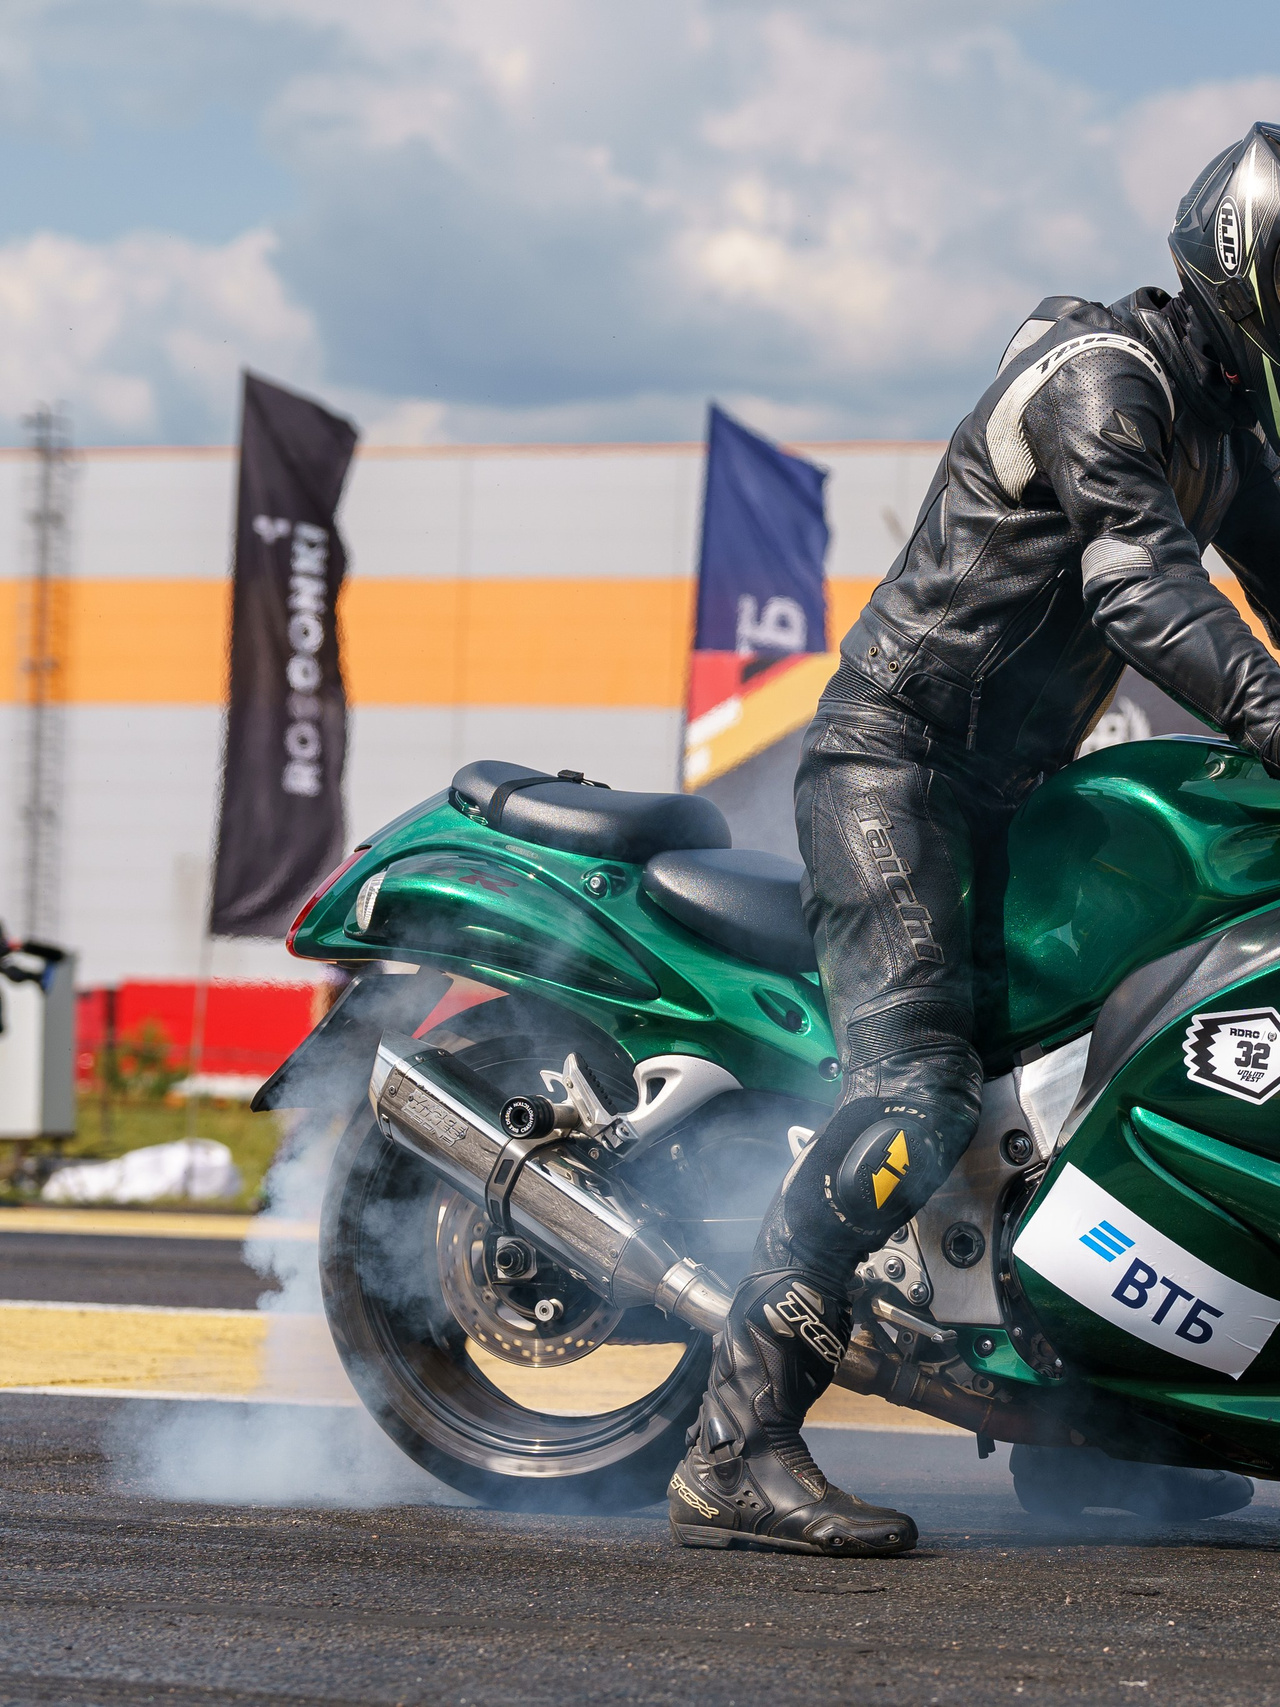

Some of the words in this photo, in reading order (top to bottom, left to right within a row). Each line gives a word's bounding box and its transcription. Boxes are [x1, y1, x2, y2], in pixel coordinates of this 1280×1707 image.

[1221, 207, 1237, 265] HJC
[852, 794, 945, 965] Taichi
[1229, 1027, 1261, 1039] RDRC
[1234, 1040, 1271, 1070] 32
[1240, 1075, 1262, 1083] FEST
[1111, 1257, 1225, 1344] ВТБ
[670, 1473, 719, 1519] TCX
